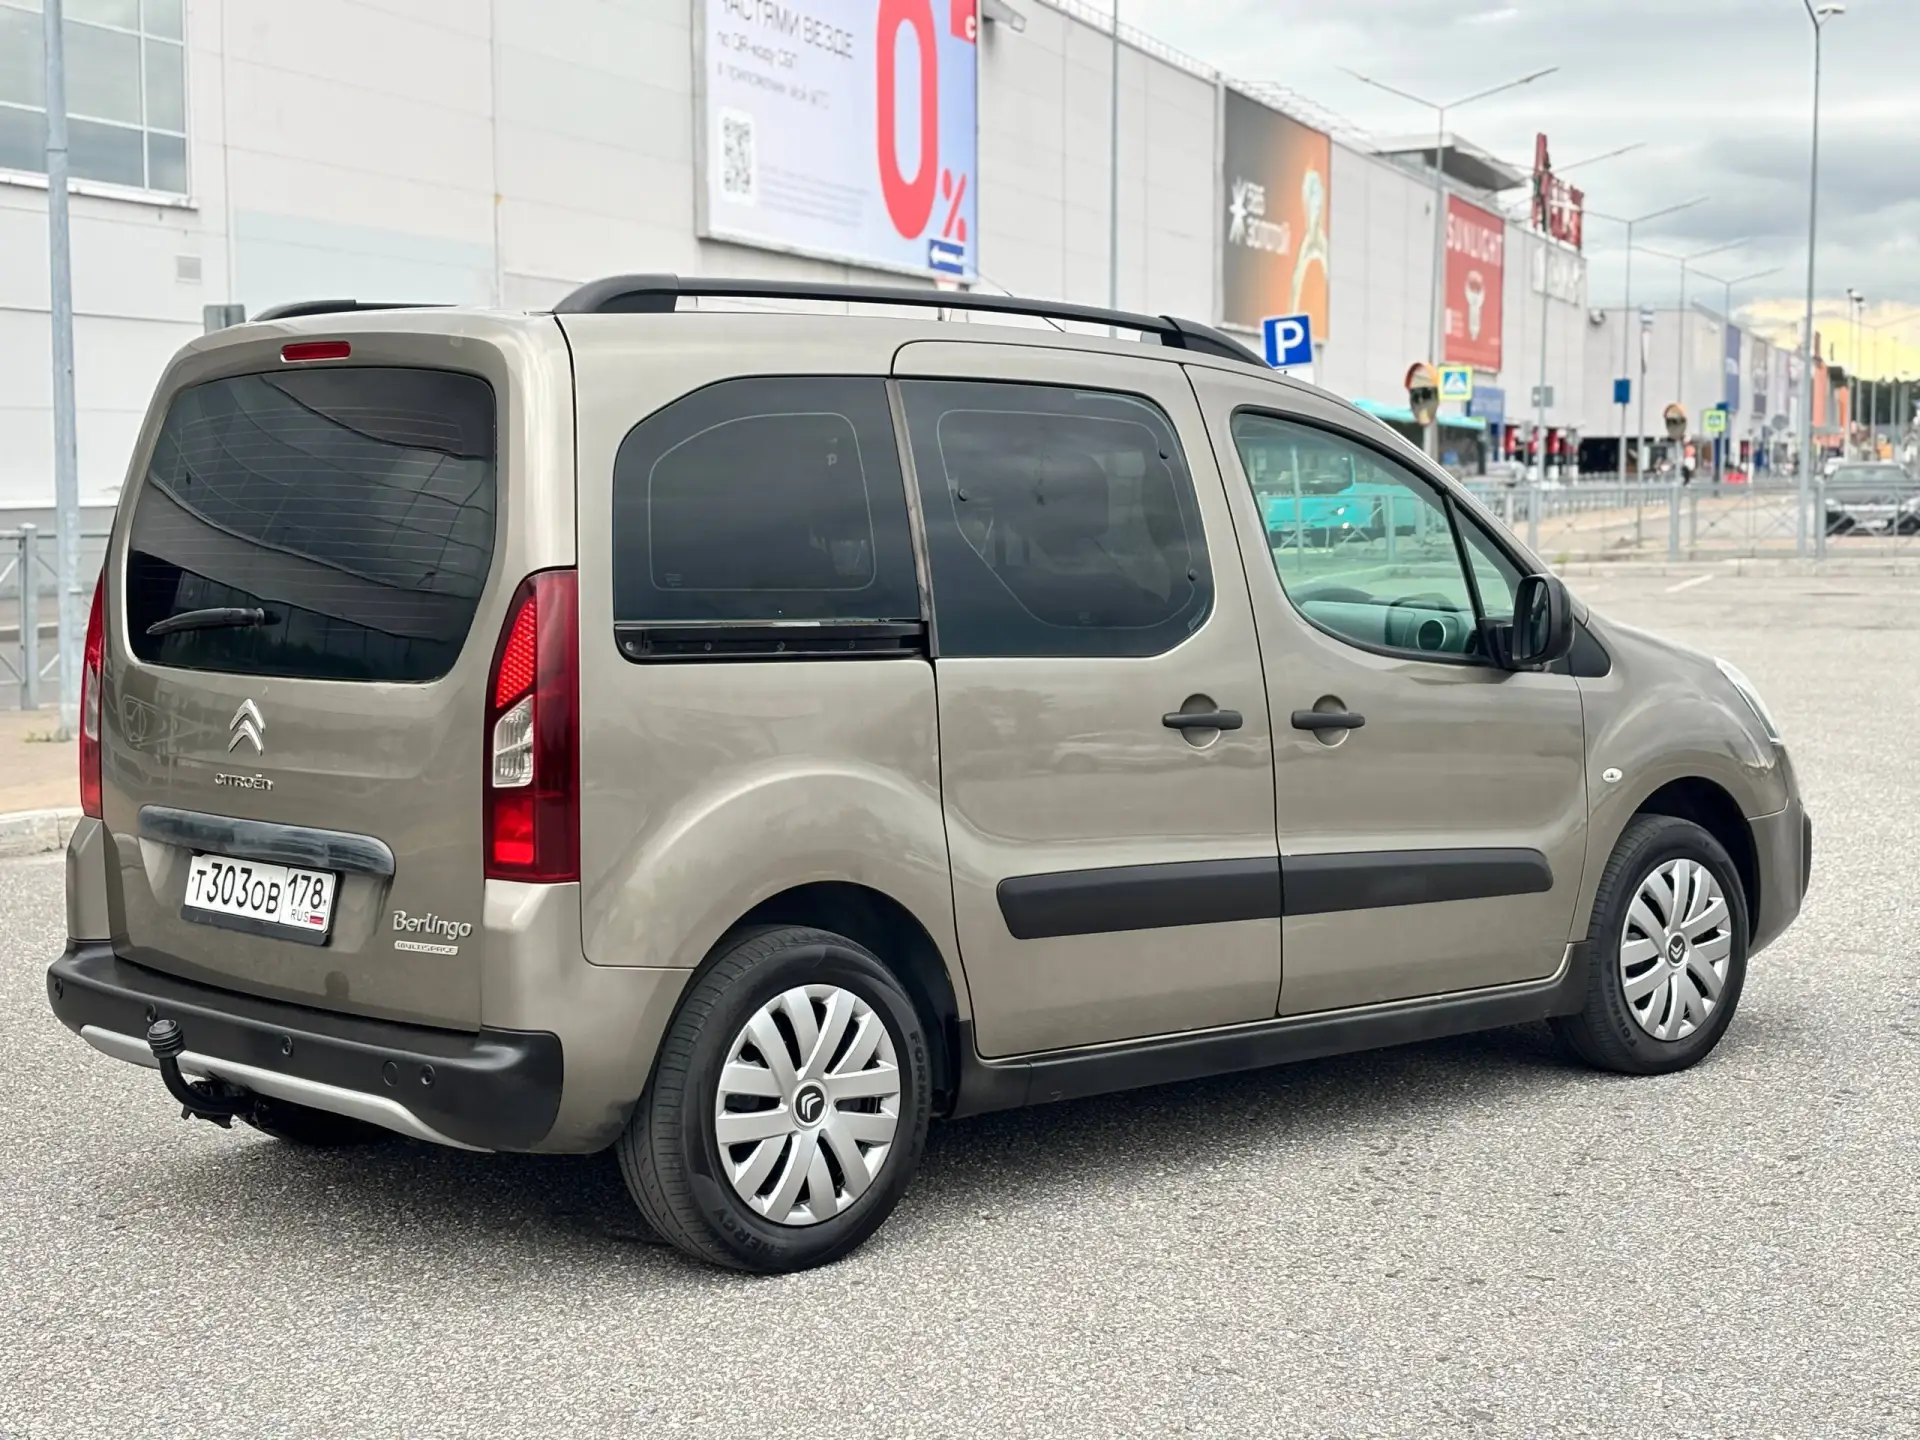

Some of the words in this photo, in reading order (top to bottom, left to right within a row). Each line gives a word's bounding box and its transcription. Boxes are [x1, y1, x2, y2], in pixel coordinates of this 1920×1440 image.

[803, 15, 854, 60] ВЕЗДЕ
[1447, 212, 1502, 268] SUNLIGHT
[1275, 320, 1304, 364] P
[287, 873, 324, 909] 178
[290, 909, 310, 922] RUS
[392, 910, 473, 940] Berlingo
[396, 941, 457, 954] MULTISPACE
